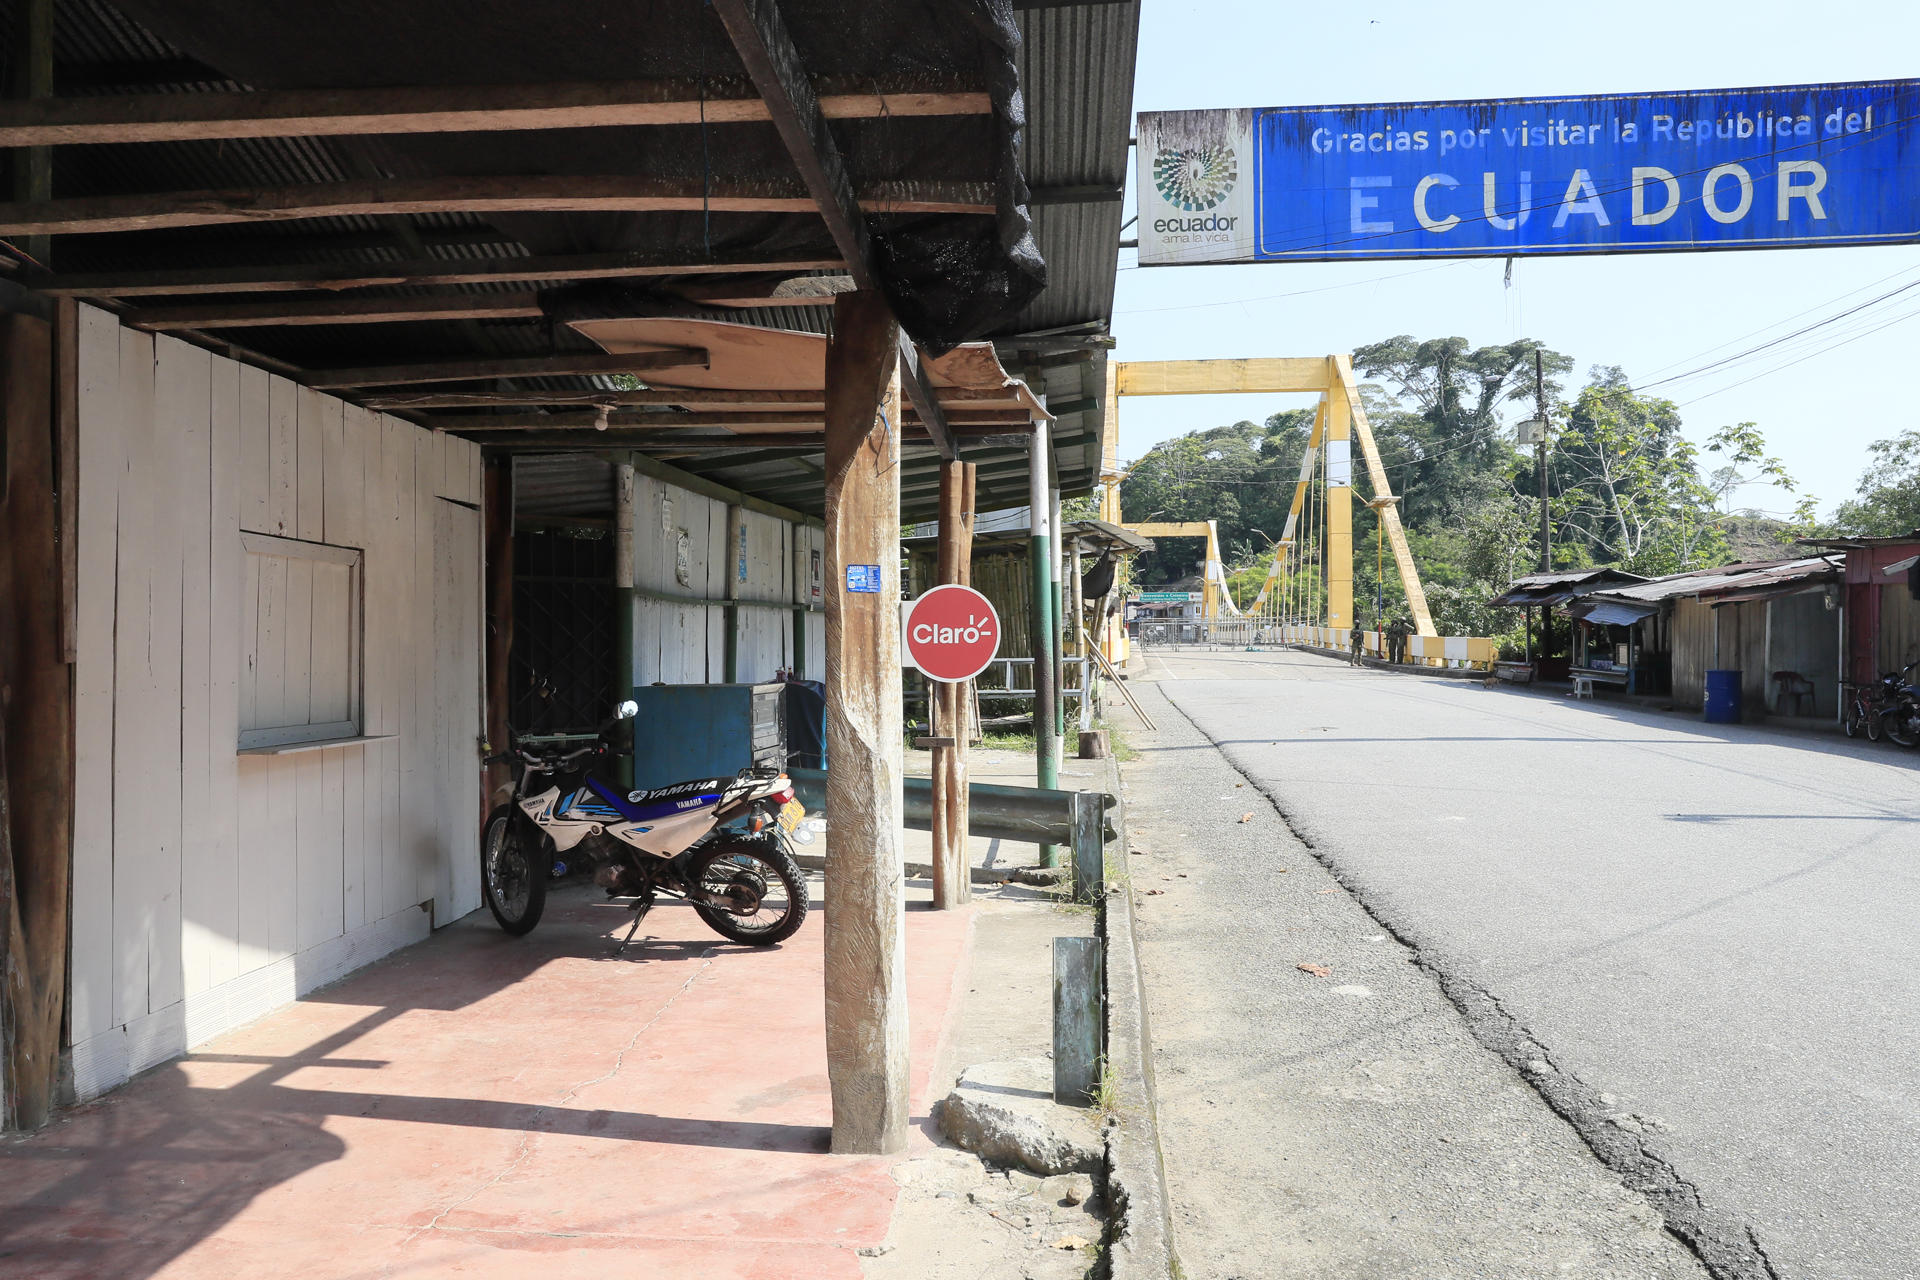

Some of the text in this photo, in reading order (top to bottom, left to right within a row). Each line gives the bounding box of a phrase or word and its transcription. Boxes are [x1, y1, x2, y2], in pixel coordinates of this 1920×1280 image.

[1312, 105, 1873, 157] Gracias por visitar la República del
[1350, 160, 1828, 234] ECUADOR
[1153, 213, 1238, 233] ecuador
[1162, 231, 1230, 244] ama la vida
[912, 623, 981, 644] Claro
[648, 780, 718, 800] YAMAHA
[677, 798, 704, 809] YAMAHA
